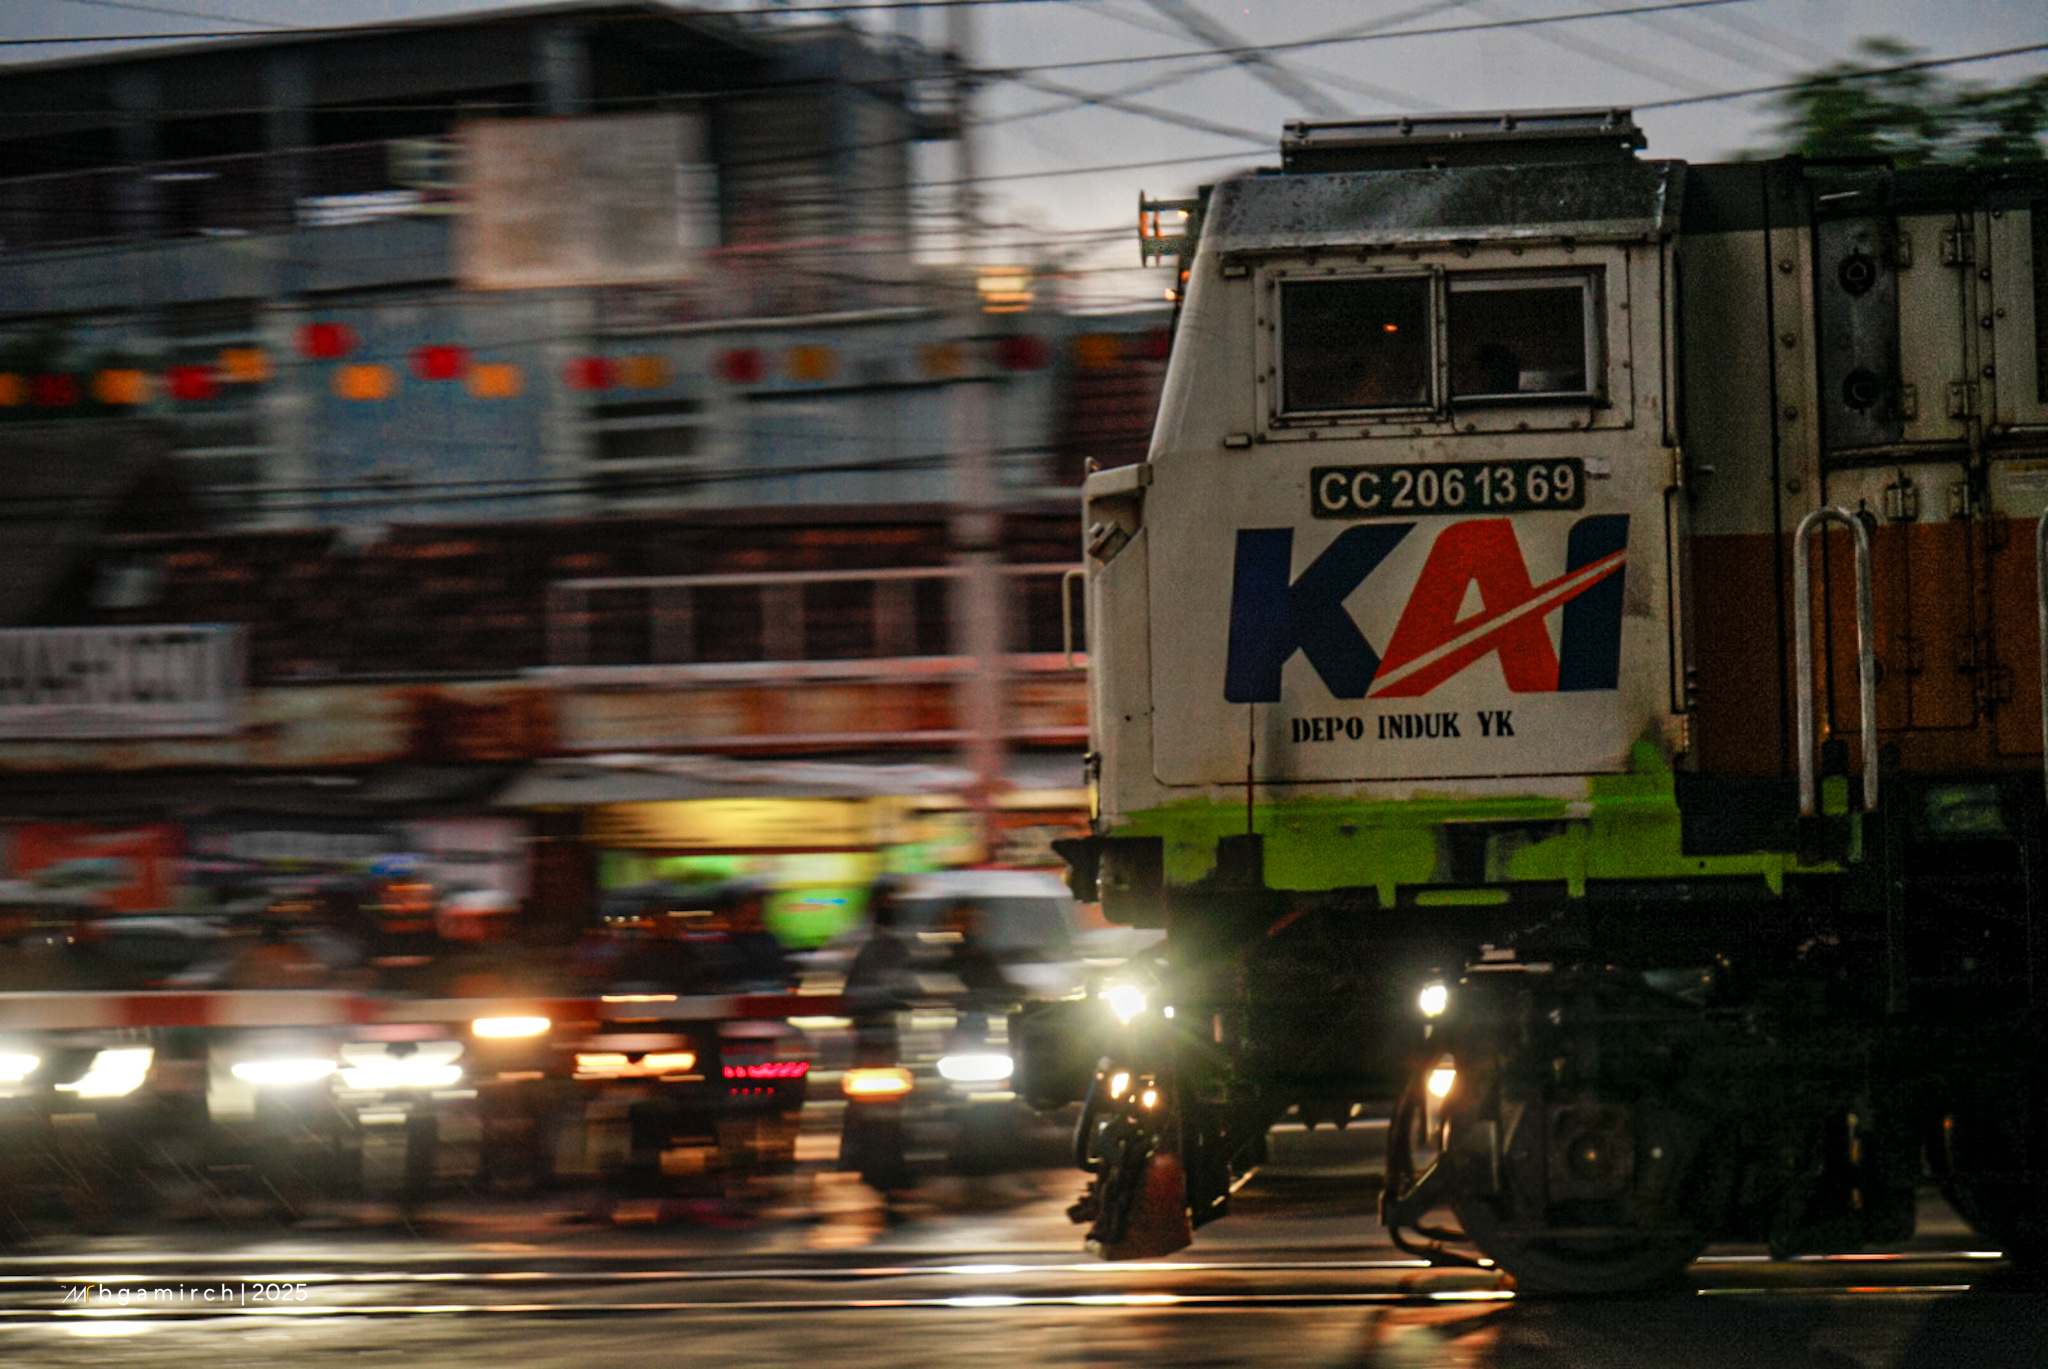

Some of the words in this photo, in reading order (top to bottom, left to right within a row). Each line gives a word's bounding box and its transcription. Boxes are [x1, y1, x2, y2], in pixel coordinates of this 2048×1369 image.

[1320, 472, 1381, 510] CC
[1391, 468, 1466, 508] 206
[1475, 466, 1518, 505] 13
[1526, 464, 1576, 503] 69
[1224, 513, 1631, 703] KAI
[1292, 716, 1364, 743] DEPO
[1378, 712, 1461, 740] INDUK
[1477, 710, 1515, 737] YK
